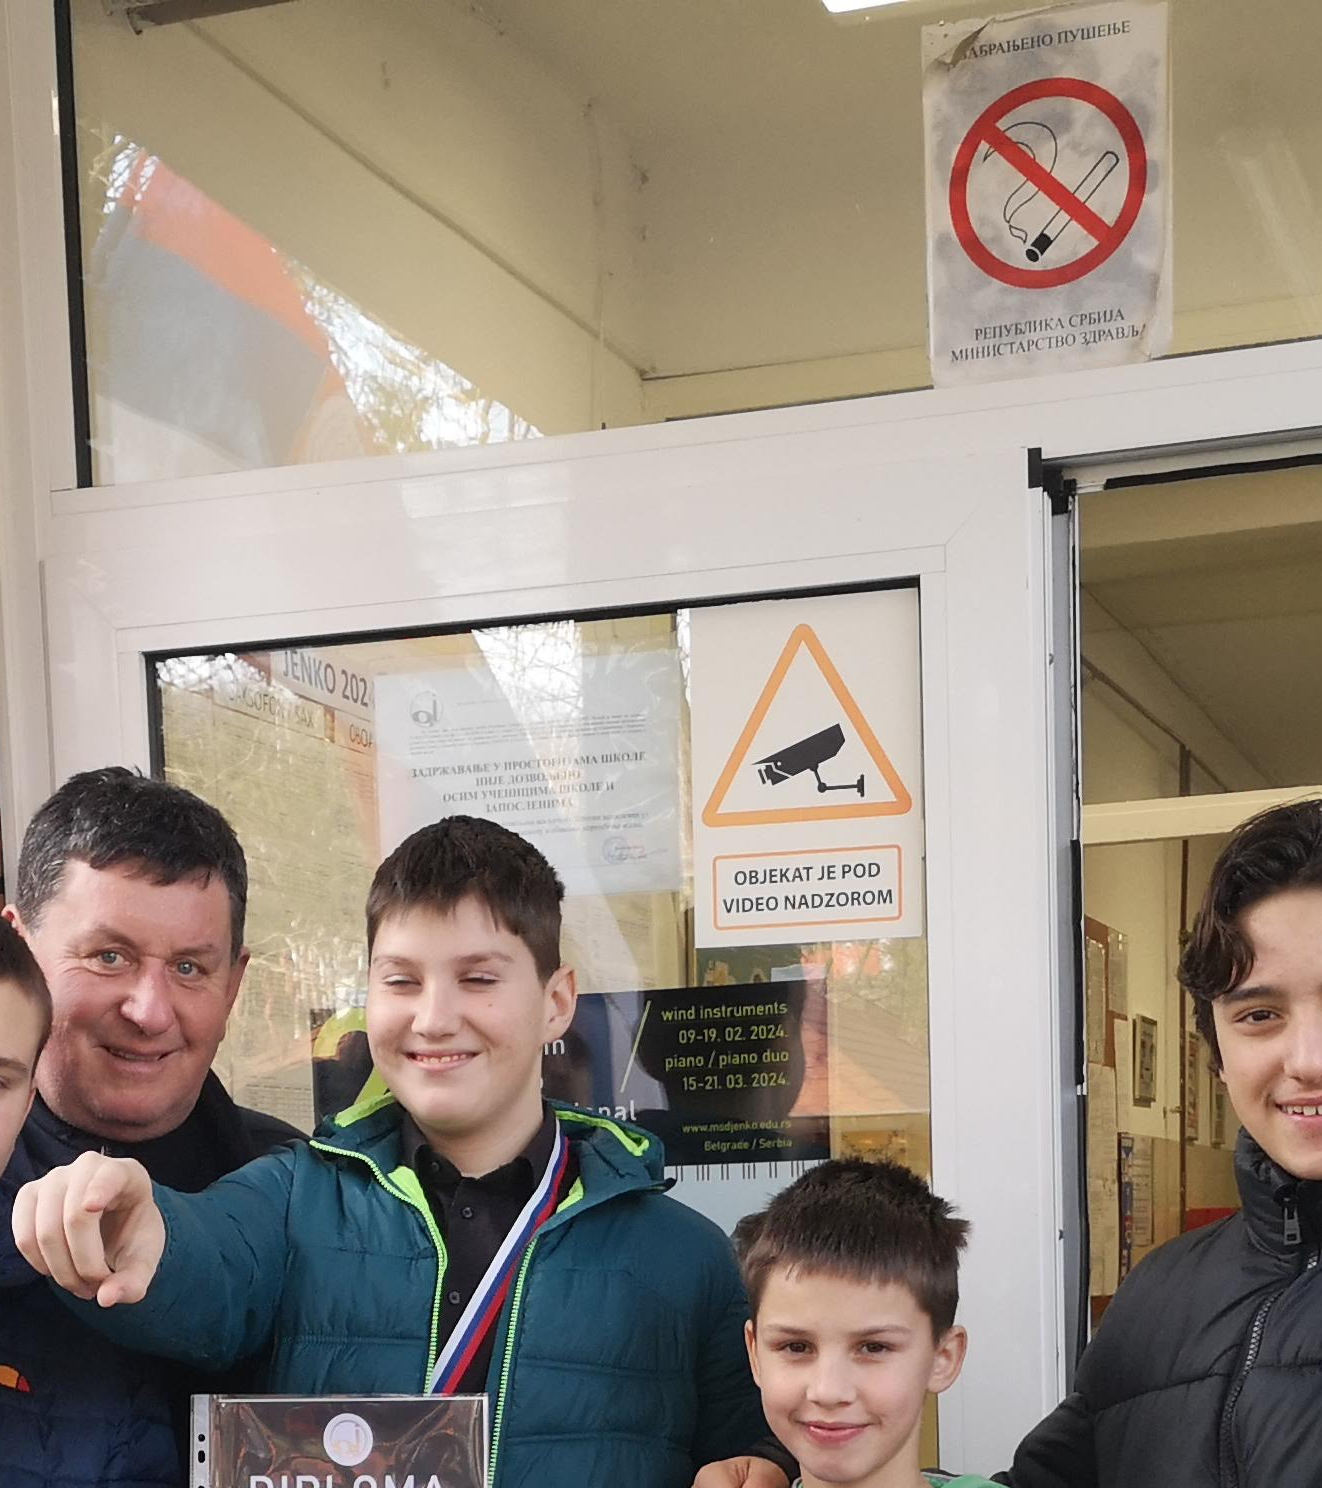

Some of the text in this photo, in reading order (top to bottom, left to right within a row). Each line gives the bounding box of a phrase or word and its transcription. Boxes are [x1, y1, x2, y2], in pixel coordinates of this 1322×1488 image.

[962, 20, 1131, 61] АБРАЊЕНО ПУШЕЊЕ
[974, 308, 1125, 341] РЕПУБЛИКА СРБИЈА
[950, 334, 1076, 362] МИНИСТАРСТВО
[283, 650, 336, 694] JENKO
[601, 751, 646, 762] ШКОЛЕ
[734, 863, 881, 886] OBJEKAT JE POD
[723, 889, 893, 914] VIDEO NADZOROM
[661, 1001, 788, 1022] wind instruments
[678, 1024, 789, 1045] 09-19. 02. 2024.
[665, 1048, 789, 1070] piano / piano duo
[682, 1072, 790, 1091] 15-21. 03. 2024.
[704, 1138, 750, 1153] Belgrade
[759, 1137, 793, 1150] Serbia
